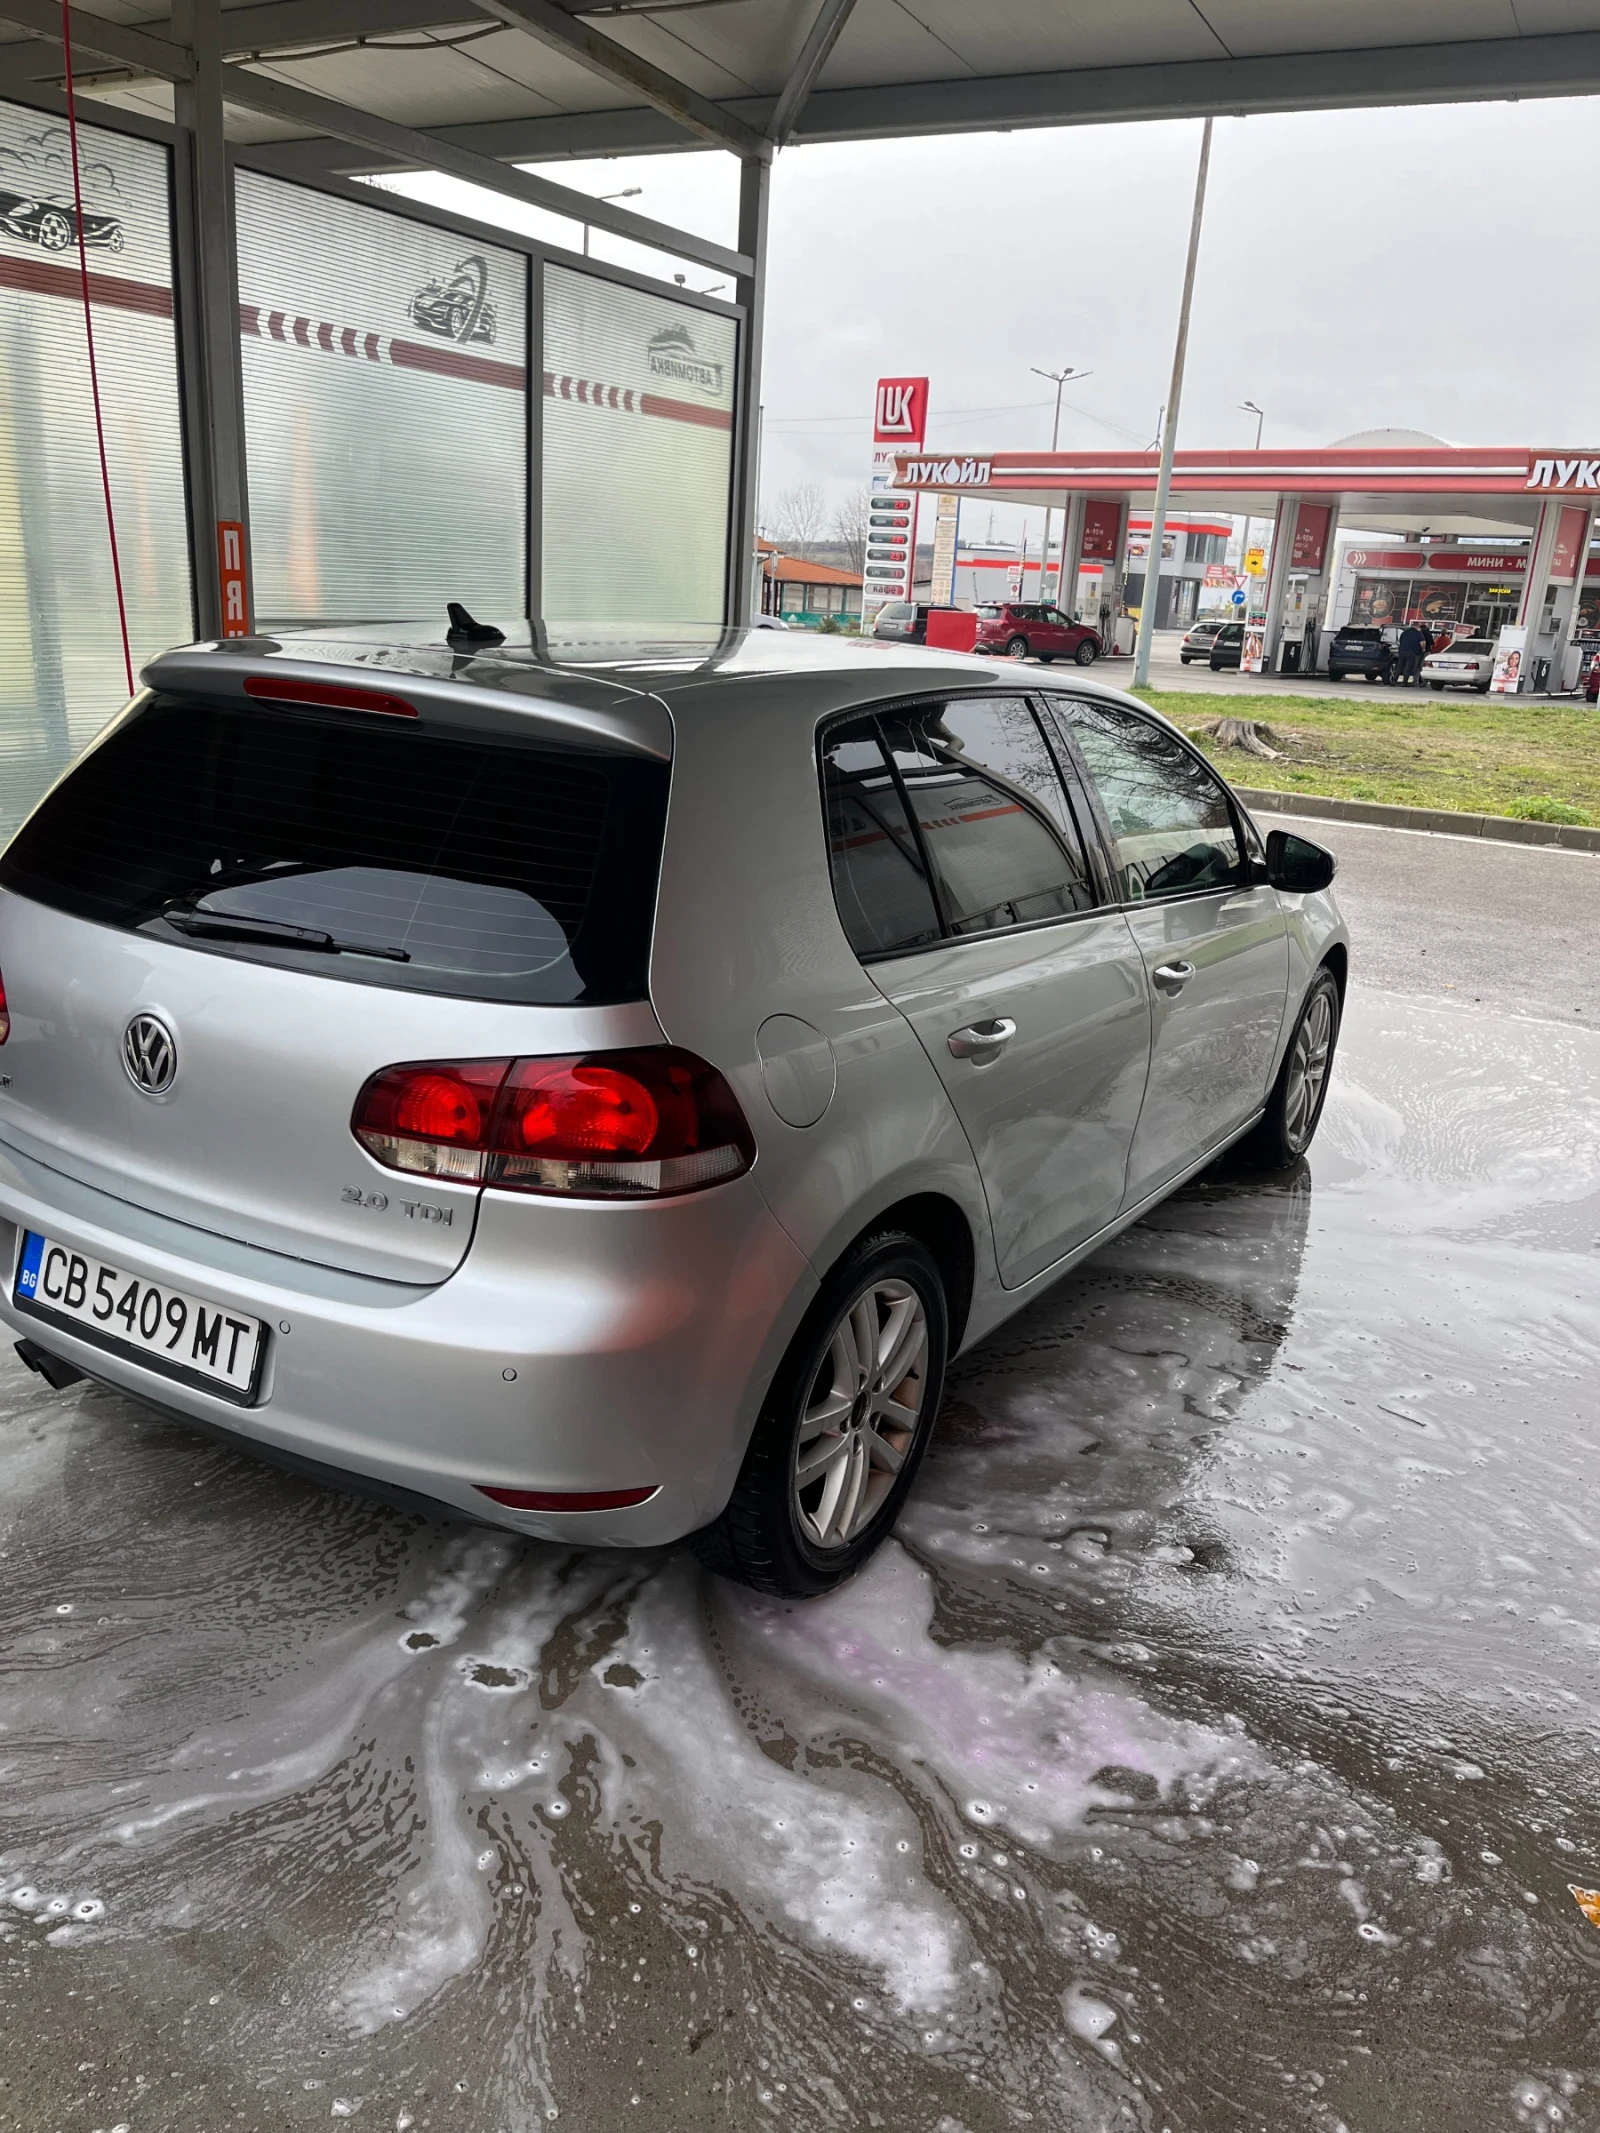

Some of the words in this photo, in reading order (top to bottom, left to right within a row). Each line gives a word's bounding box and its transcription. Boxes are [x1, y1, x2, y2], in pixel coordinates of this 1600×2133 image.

[903, 457, 991, 484] ЛУКОЙЛ
[1526, 459, 1600, 488] ЛУК
[1106, 539, 1113, 551] 2
[1314, 546, 1321, 559] 4
[1467, 556, 1504, 569] МИНИ
[224, 530, 244, 638] ПЯ
[1289, 646, 1296, 658] 4
[1541, 664, 1547, 677] 6
[340, 1184, 389, 1212] 2.0
[399, 1197, 453, 1227] TDI
[21, 1268, 37, 1289] BG
